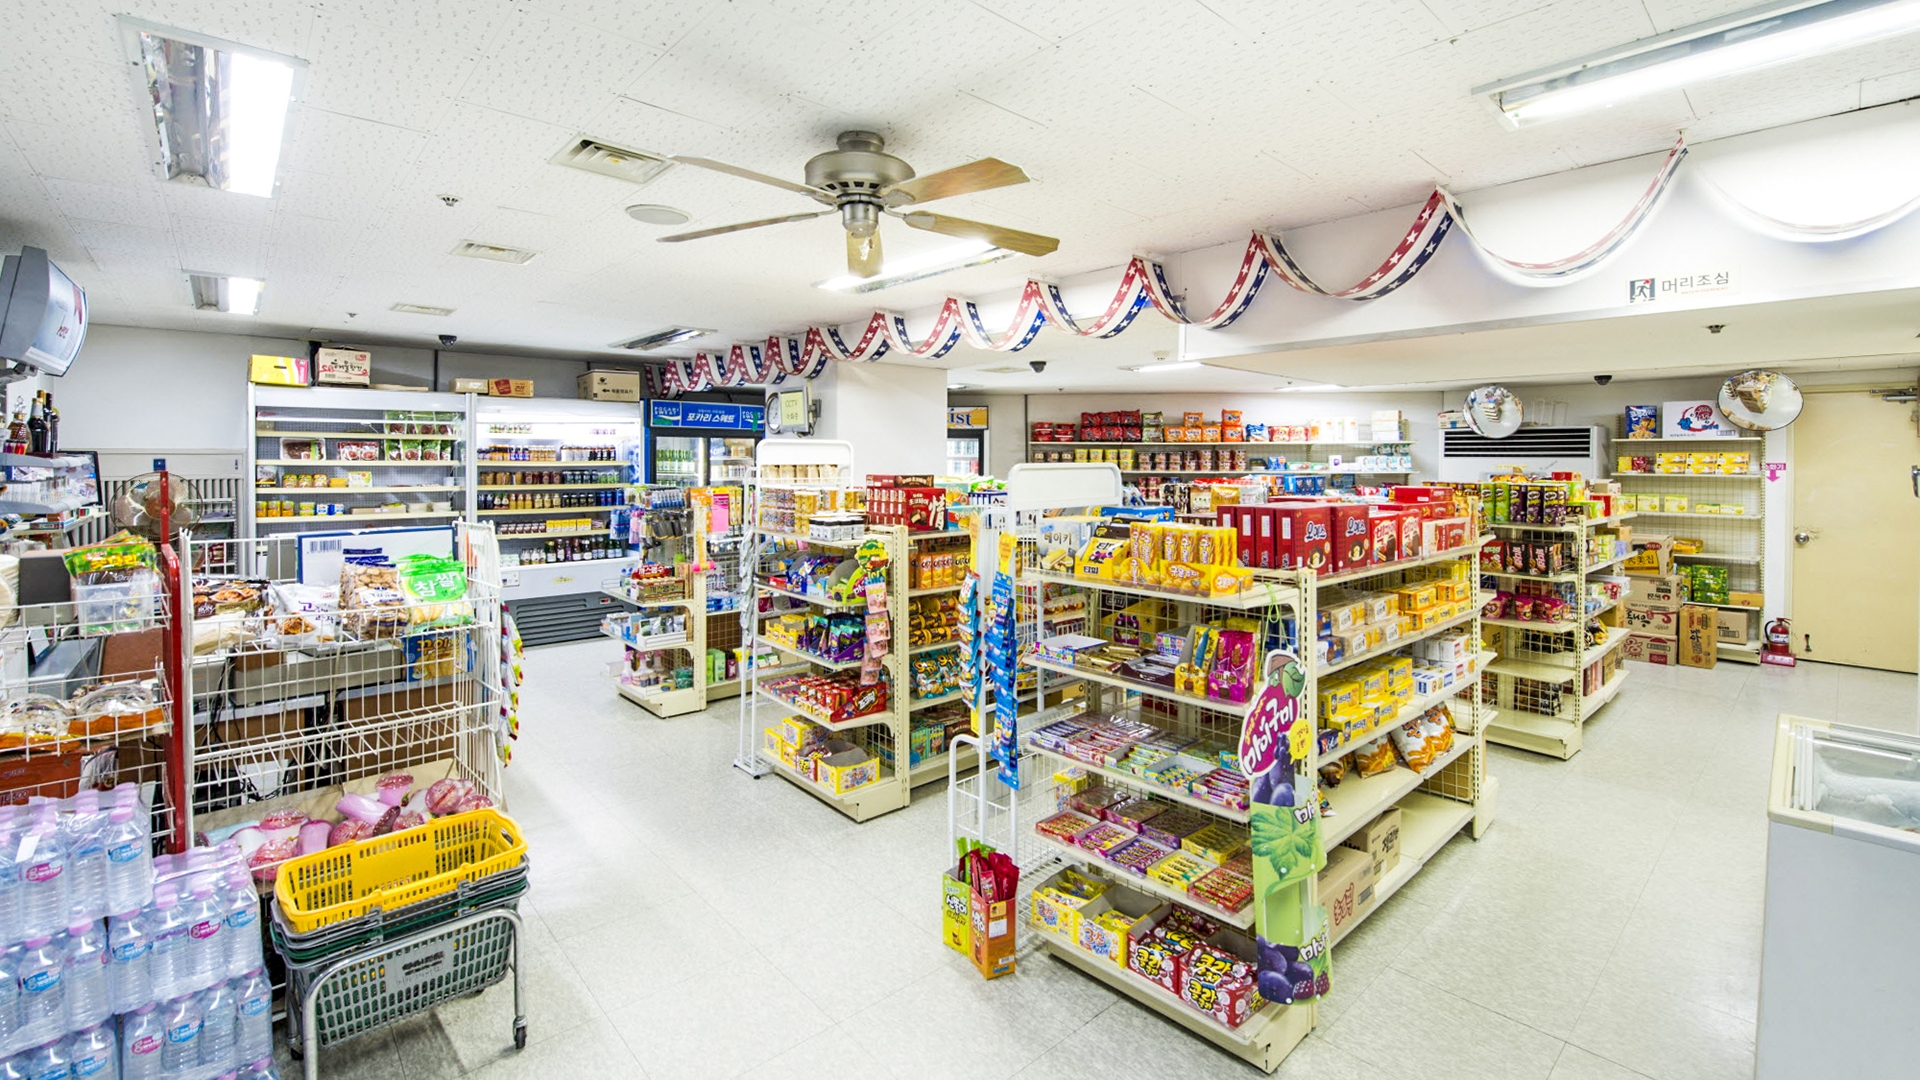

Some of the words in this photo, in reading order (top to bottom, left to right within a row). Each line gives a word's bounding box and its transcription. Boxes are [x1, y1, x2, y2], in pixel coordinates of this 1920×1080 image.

[1661, 271, 1729, 293] 머리조심
[686, 412, 712, 422] 포카리
[712, 413, 736, 423] 스웨트
[928, 493, 946, 530] 情
[1304, 520, 1327, 543] 오예스
[1345, 516, 1367, 537] 오예스
[1043, 532, 1072, 546] 베이키
[1242, 697, 1295, 776] 마이구미
